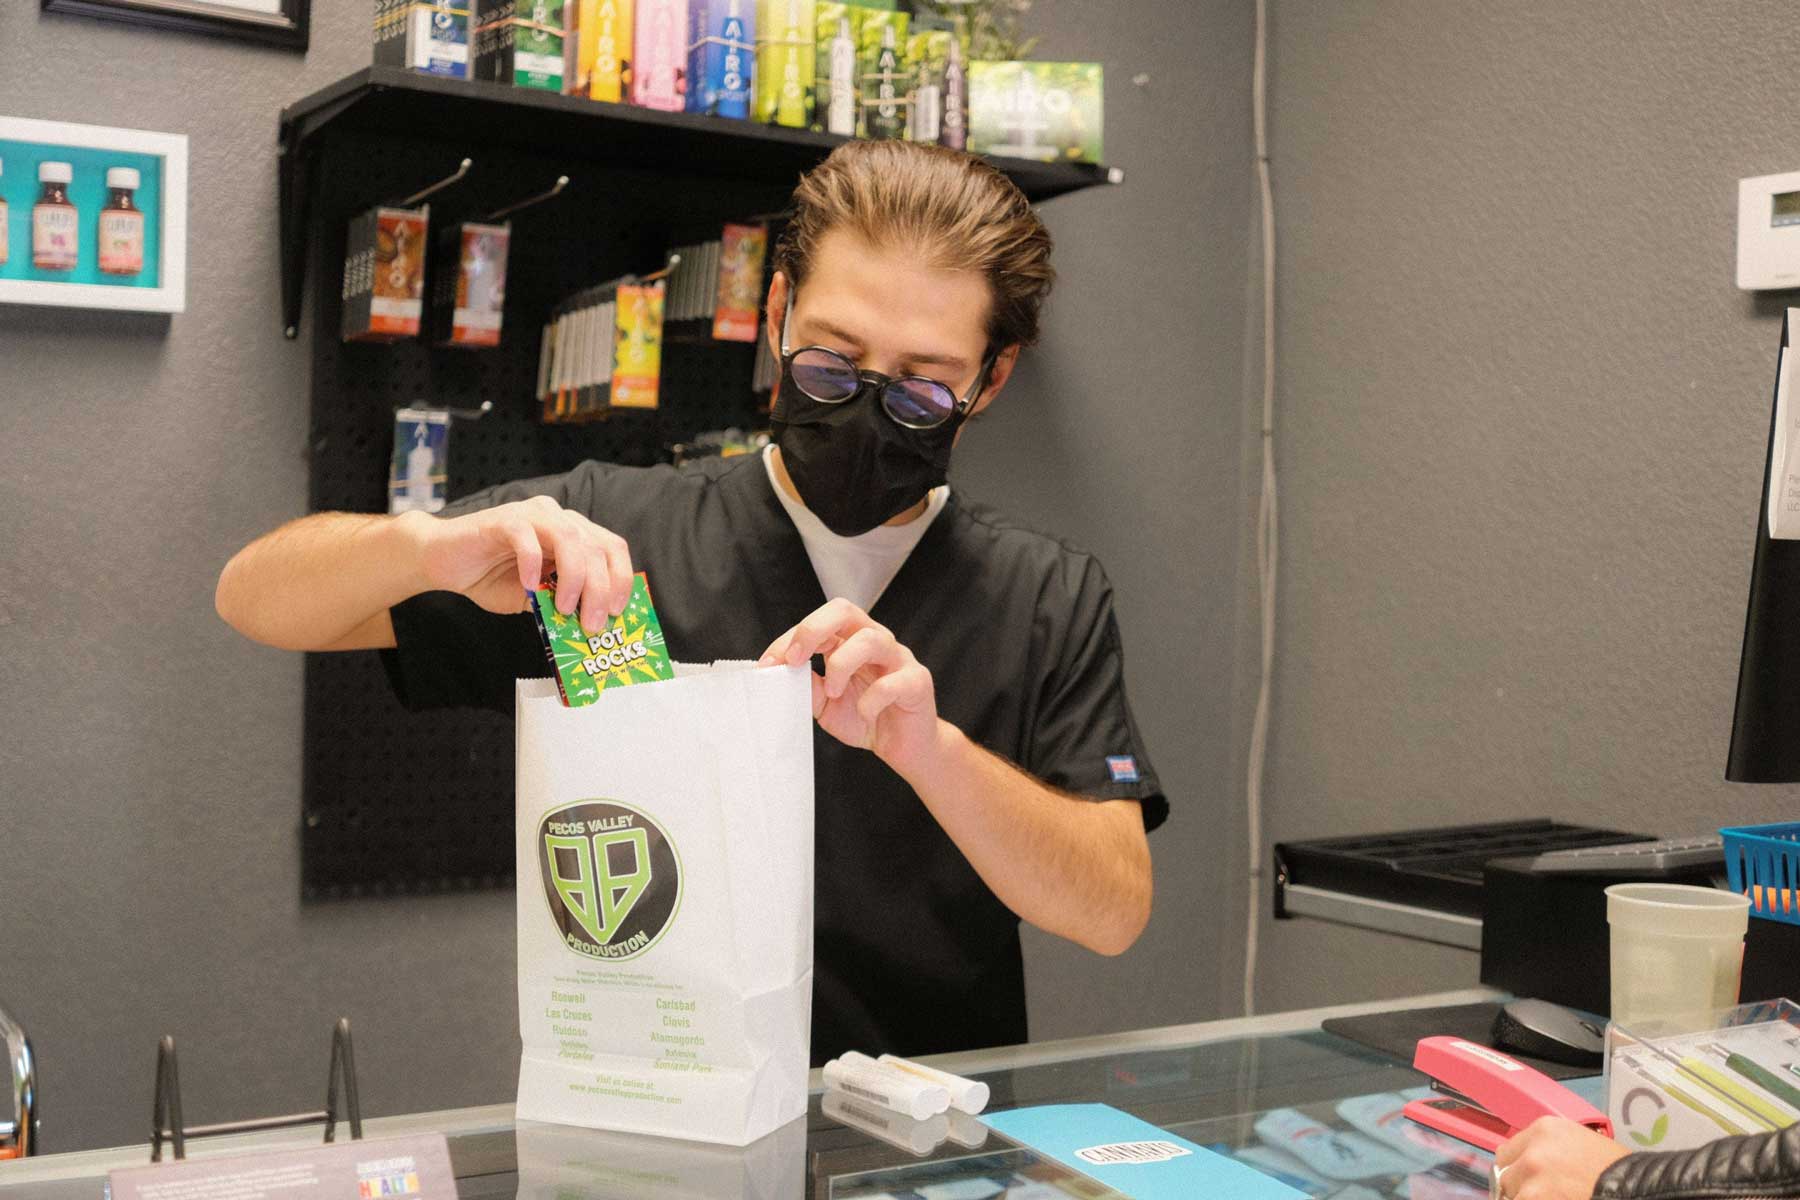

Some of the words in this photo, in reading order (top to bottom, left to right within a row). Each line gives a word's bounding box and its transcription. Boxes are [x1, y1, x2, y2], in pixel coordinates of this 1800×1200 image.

[587, 627, 624, 655] POT
[582, 641, 648, 676] ROCKS
[548, 821, 585, 835] PECOS
[587, 815, 634, 833] VALLEY
[566, 930, 650, 957] PRODUCTION
[656, 998, 696, 1012] Carlsbad
[663, 1015, 691, 1028] Clovis
